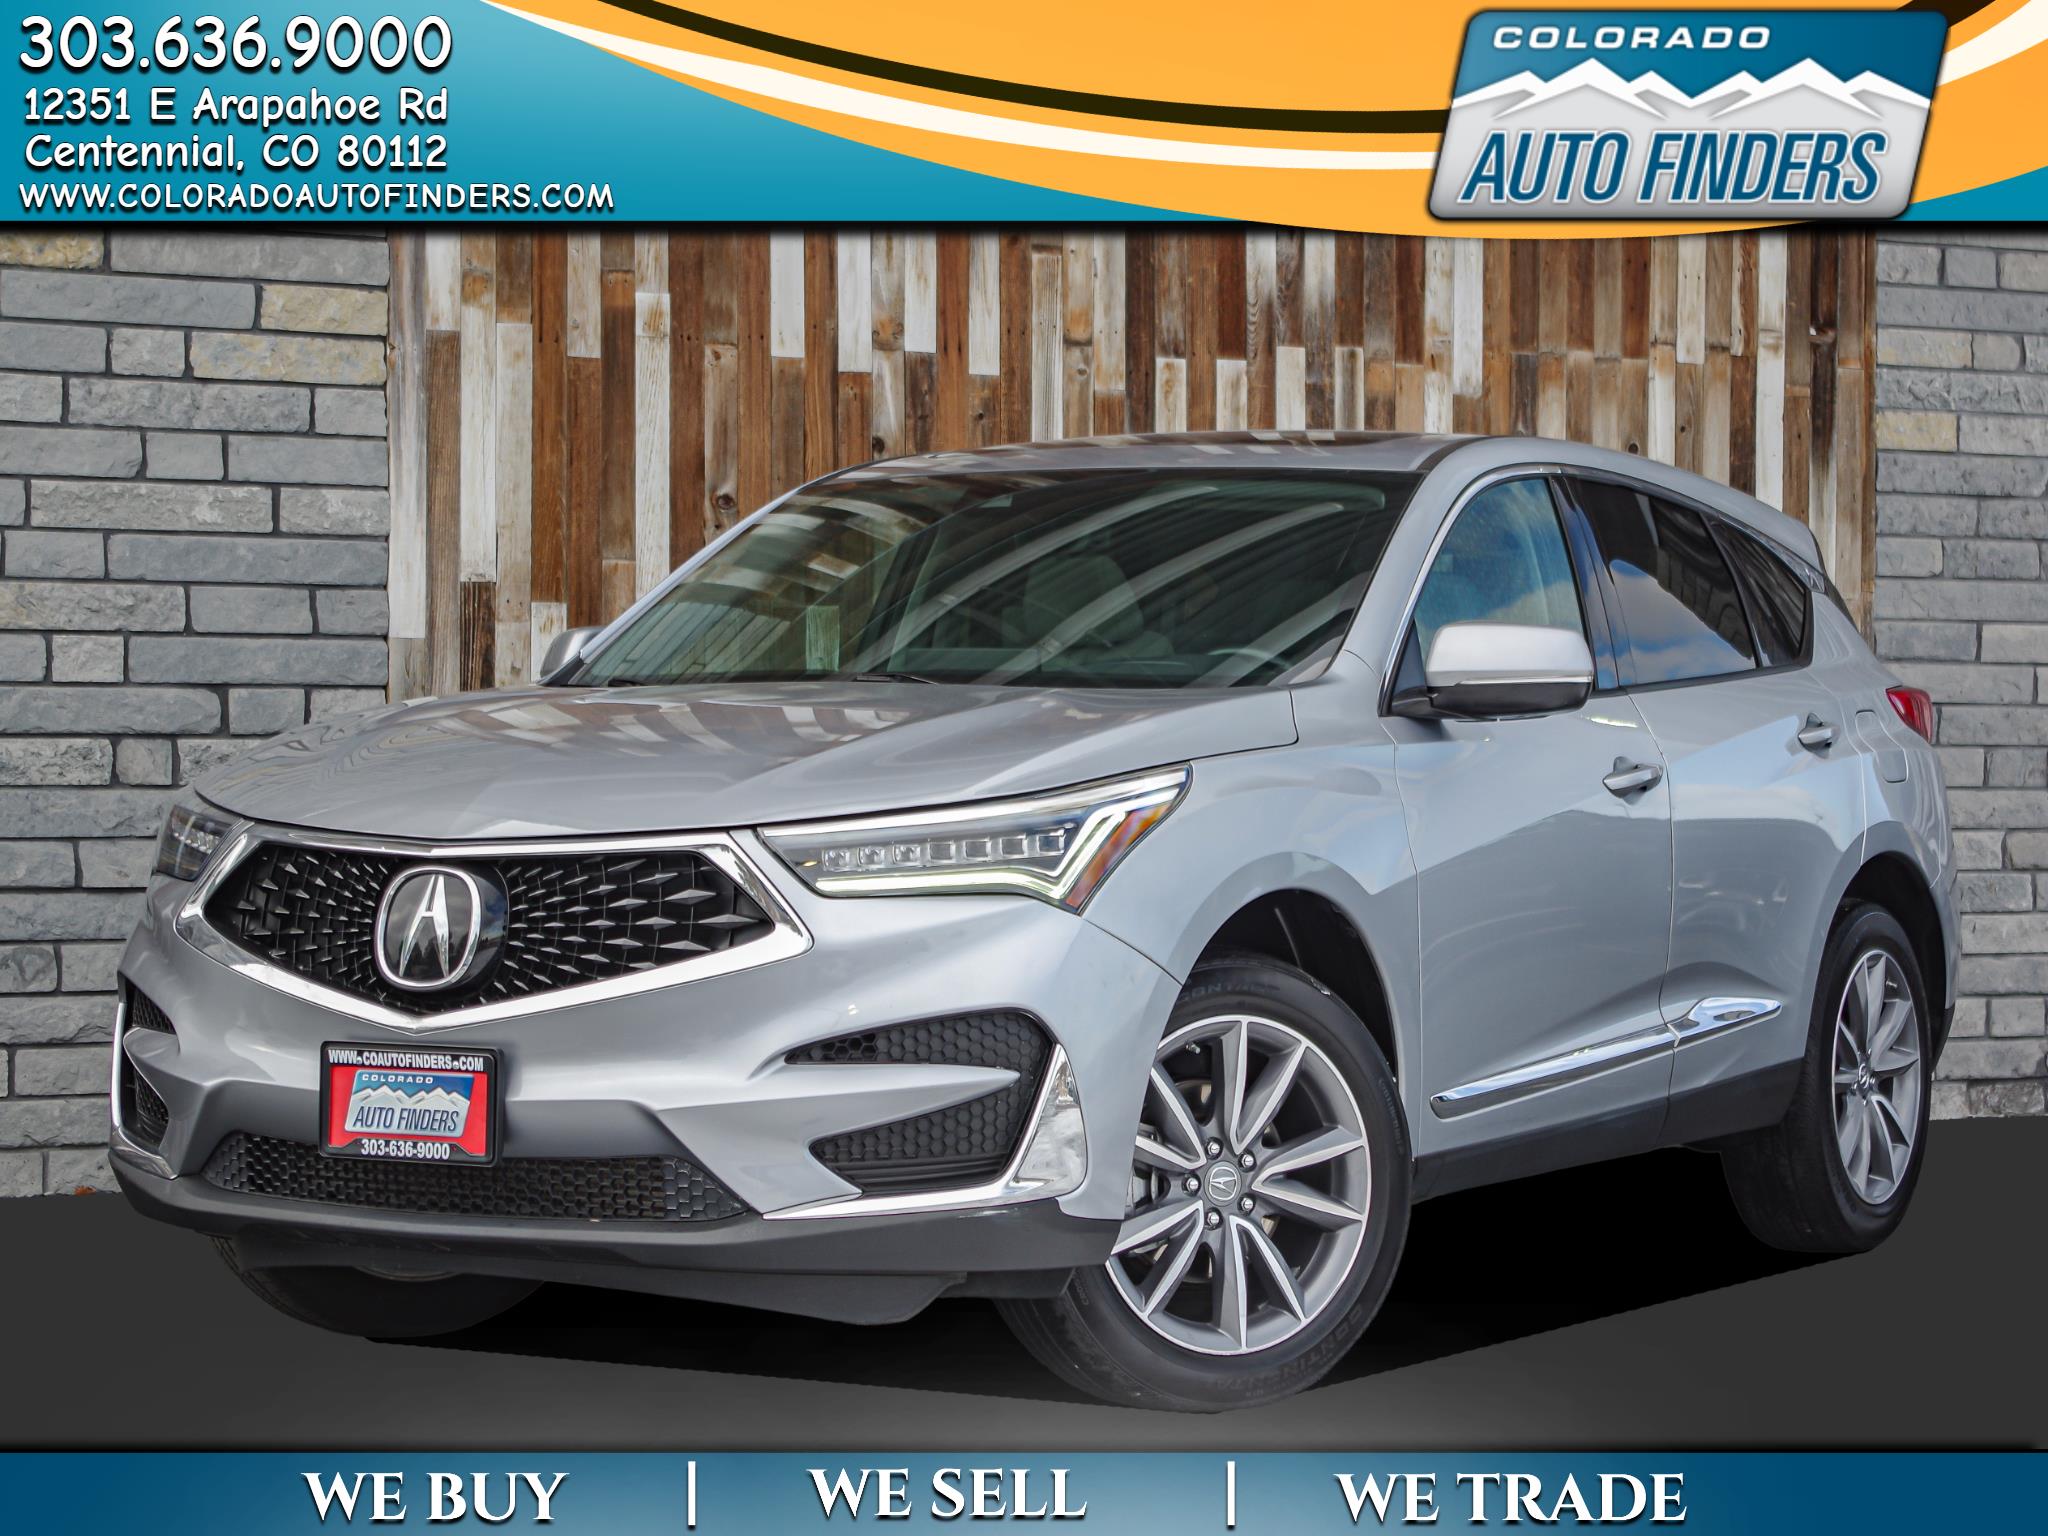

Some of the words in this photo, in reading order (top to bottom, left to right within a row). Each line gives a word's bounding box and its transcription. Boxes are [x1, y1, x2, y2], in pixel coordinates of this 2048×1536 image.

[328, 1049, 484, 1072] WWW.COAUTOFINDERS.COM
[362, 1074, 434, 1084] COLORADO
[353, 1105, 395, 1129] AUTO
[396, 1107, 459, 1132] FINDERS
[361, 1139, 450, 1160] 303-636-9000
